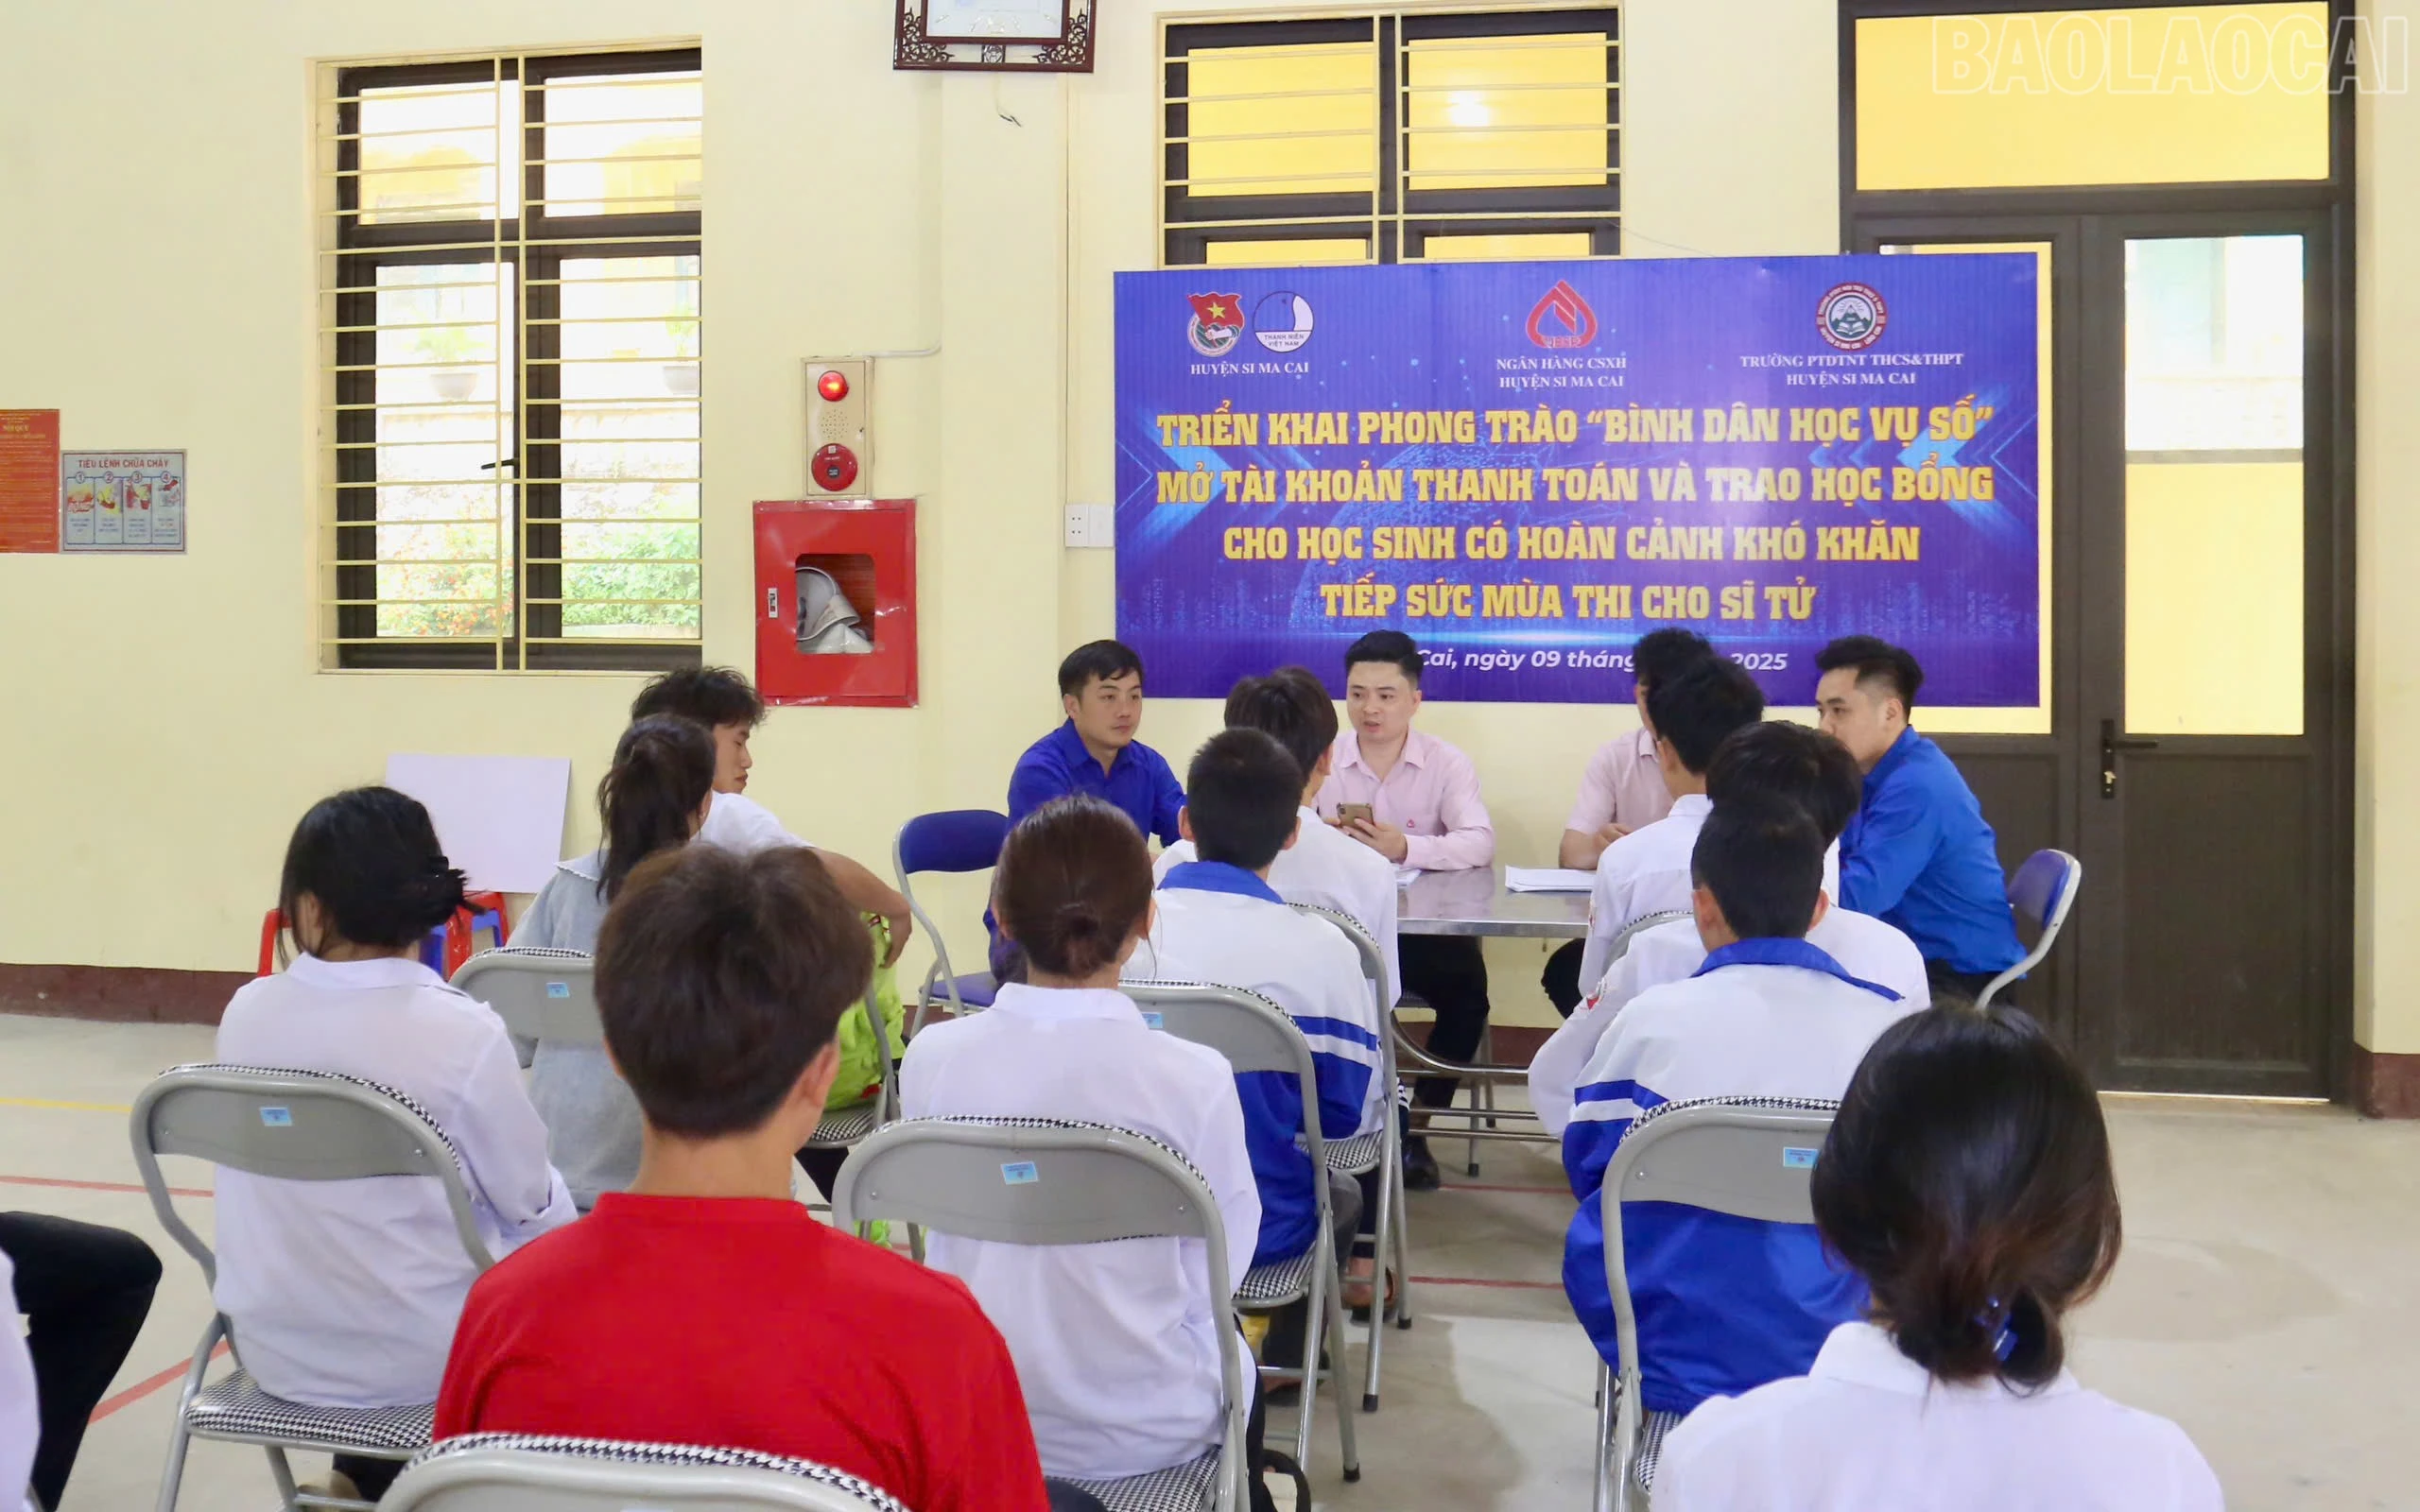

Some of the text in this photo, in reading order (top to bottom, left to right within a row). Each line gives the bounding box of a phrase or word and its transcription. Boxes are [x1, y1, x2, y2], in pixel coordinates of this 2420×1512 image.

[1191, 361, 1309, 377] HUYỆN SI MA CAI
[1496, 354, 1626, 369] NGÂN HÀNG CSXH
[1740, 352, 1963, 368] TRƯỜNG PTDTNT THCS&THPT
[1499, 373, 1623, 390] HUYỆN SI MA CAI
[1787, 371, 1916, 387] HUYỆN SI MA CAI
[1157, 394, 1995, 448] TRIỂN KHAI PHONG TRÀO “BÌNH DÂN HỌC VỤ SỐ”
[1157, 452, 1995, 507] MỞ TÀI KHOẢN THANH TOÁN VÀ TRAO HỌC BỔNG
[1223, 519, 1921, 566] CHO HỌC SINH CÓ HOÀN CẢNH KHÓ KHĂN
[1320, 573, 1817, 620] TIẾP SỨC MÙA THI CHO SĨ TỬ
[1464, 649, 1526, 671] ngày
[1531, 650, 1561, 667] 09
